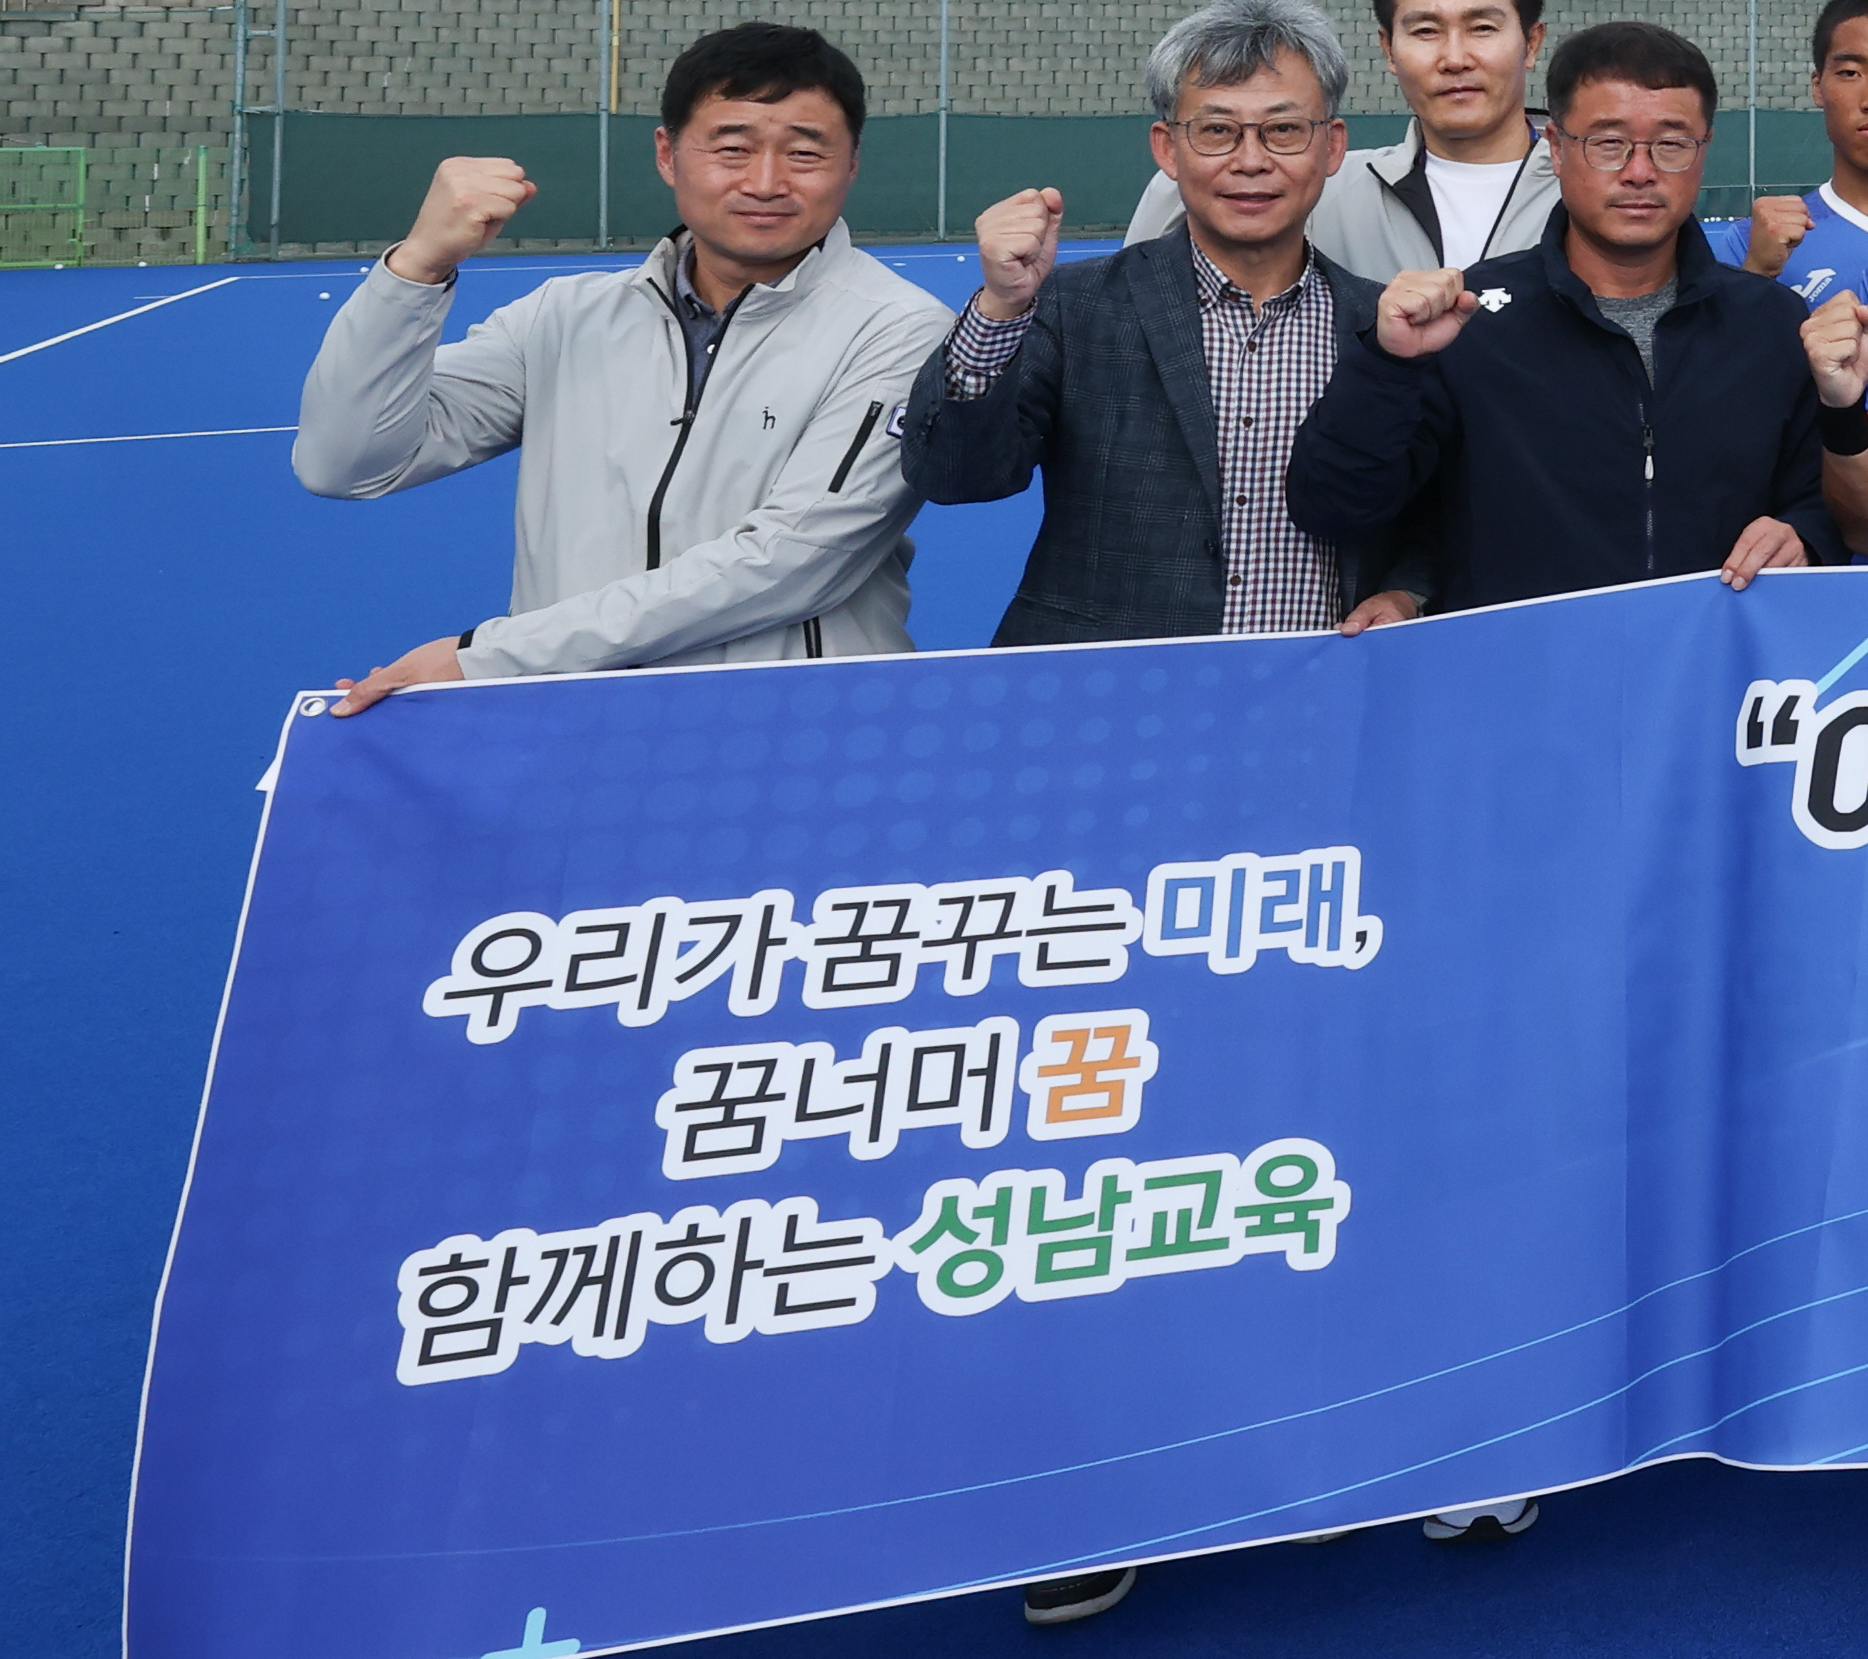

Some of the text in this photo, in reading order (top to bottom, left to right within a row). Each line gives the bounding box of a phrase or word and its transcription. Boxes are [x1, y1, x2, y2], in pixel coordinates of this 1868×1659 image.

[444, 860, 1368, 1027] 우리가 꿈꾸는 미래,
[675, 1025, 1141, 1162] 꿈너머 꿈
[416, 1153, 1334, 1367] 함께하는 성남교육
